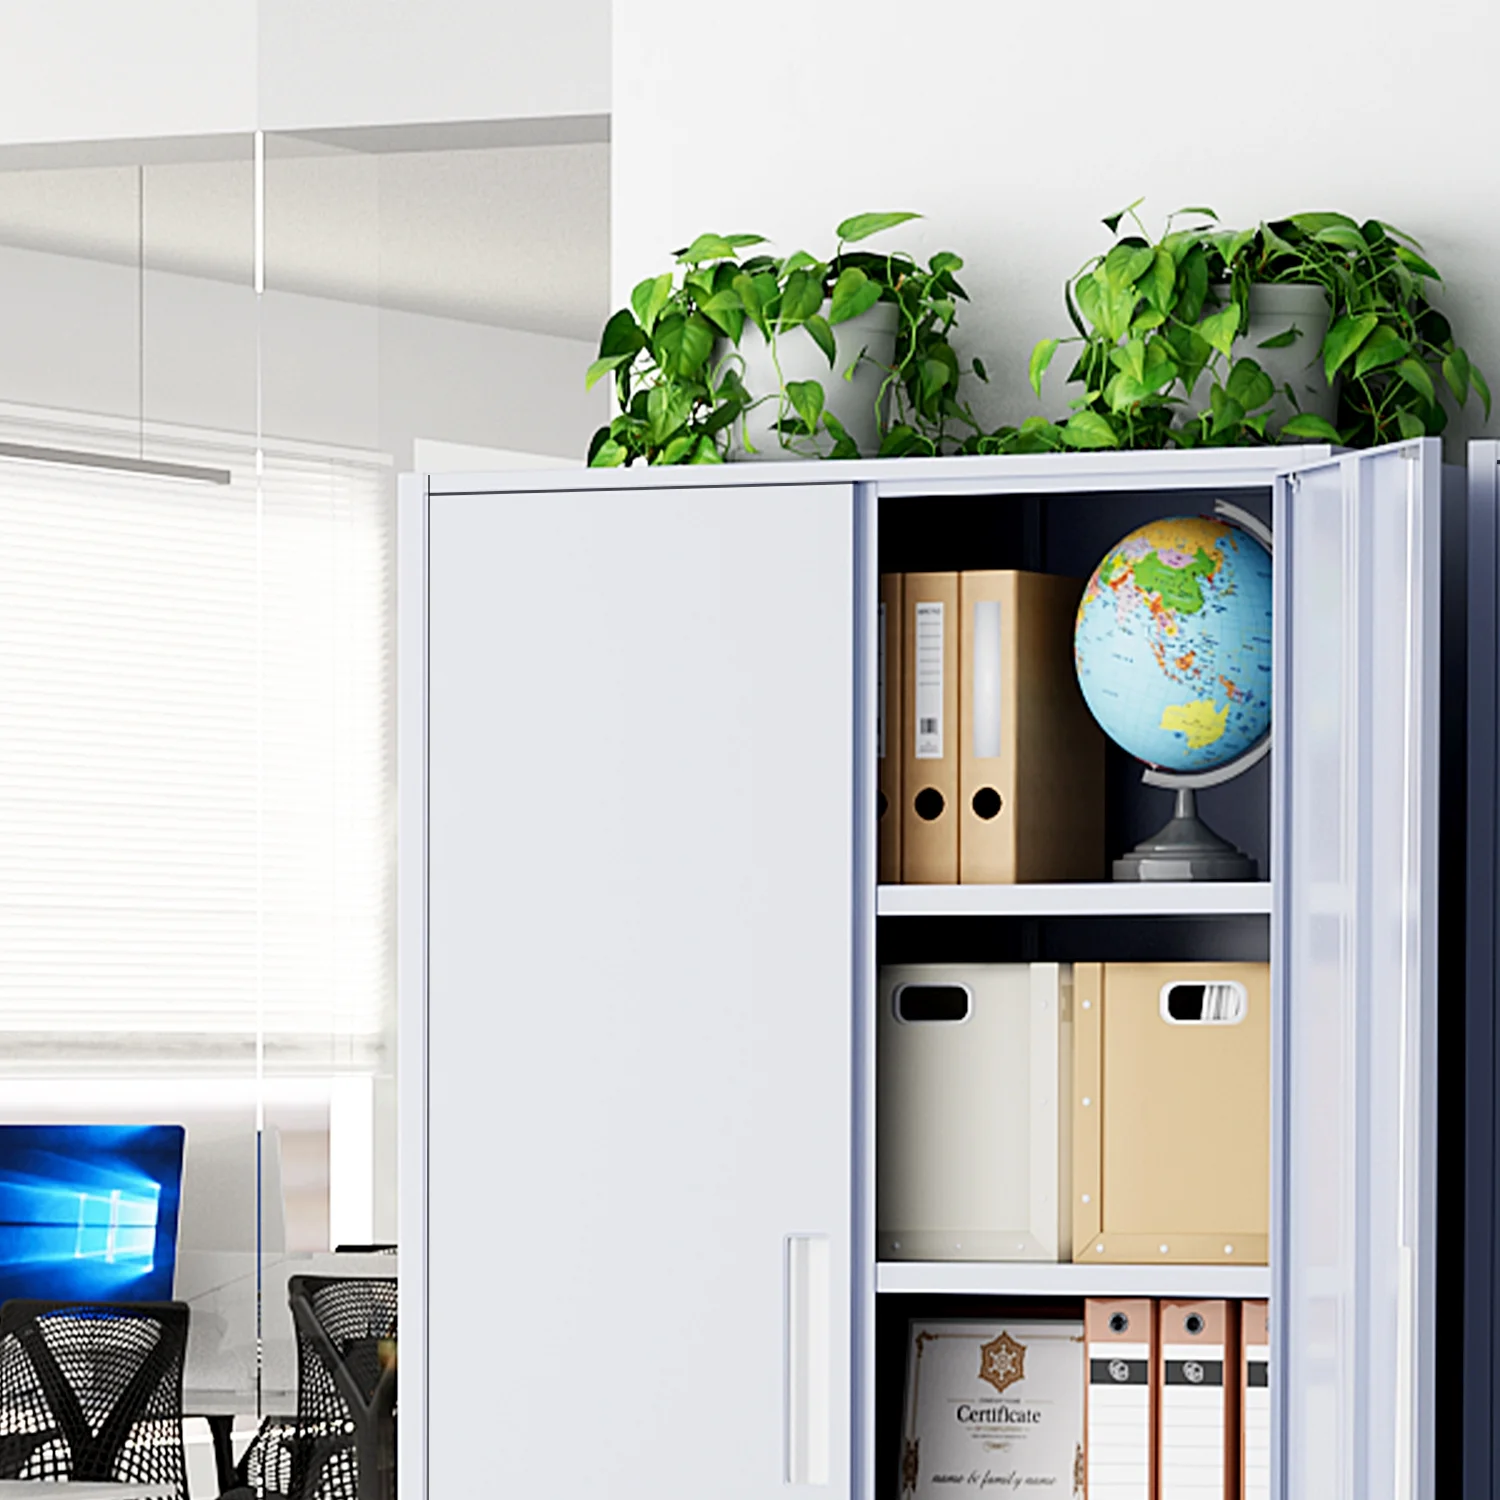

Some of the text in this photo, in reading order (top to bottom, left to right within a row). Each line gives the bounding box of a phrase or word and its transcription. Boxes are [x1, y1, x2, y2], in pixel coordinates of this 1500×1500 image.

[956, 1404, 1042, 1423] Certificate
[932, 1474, 963, 1484] name
[979, 1469, 1022, 1491] family
